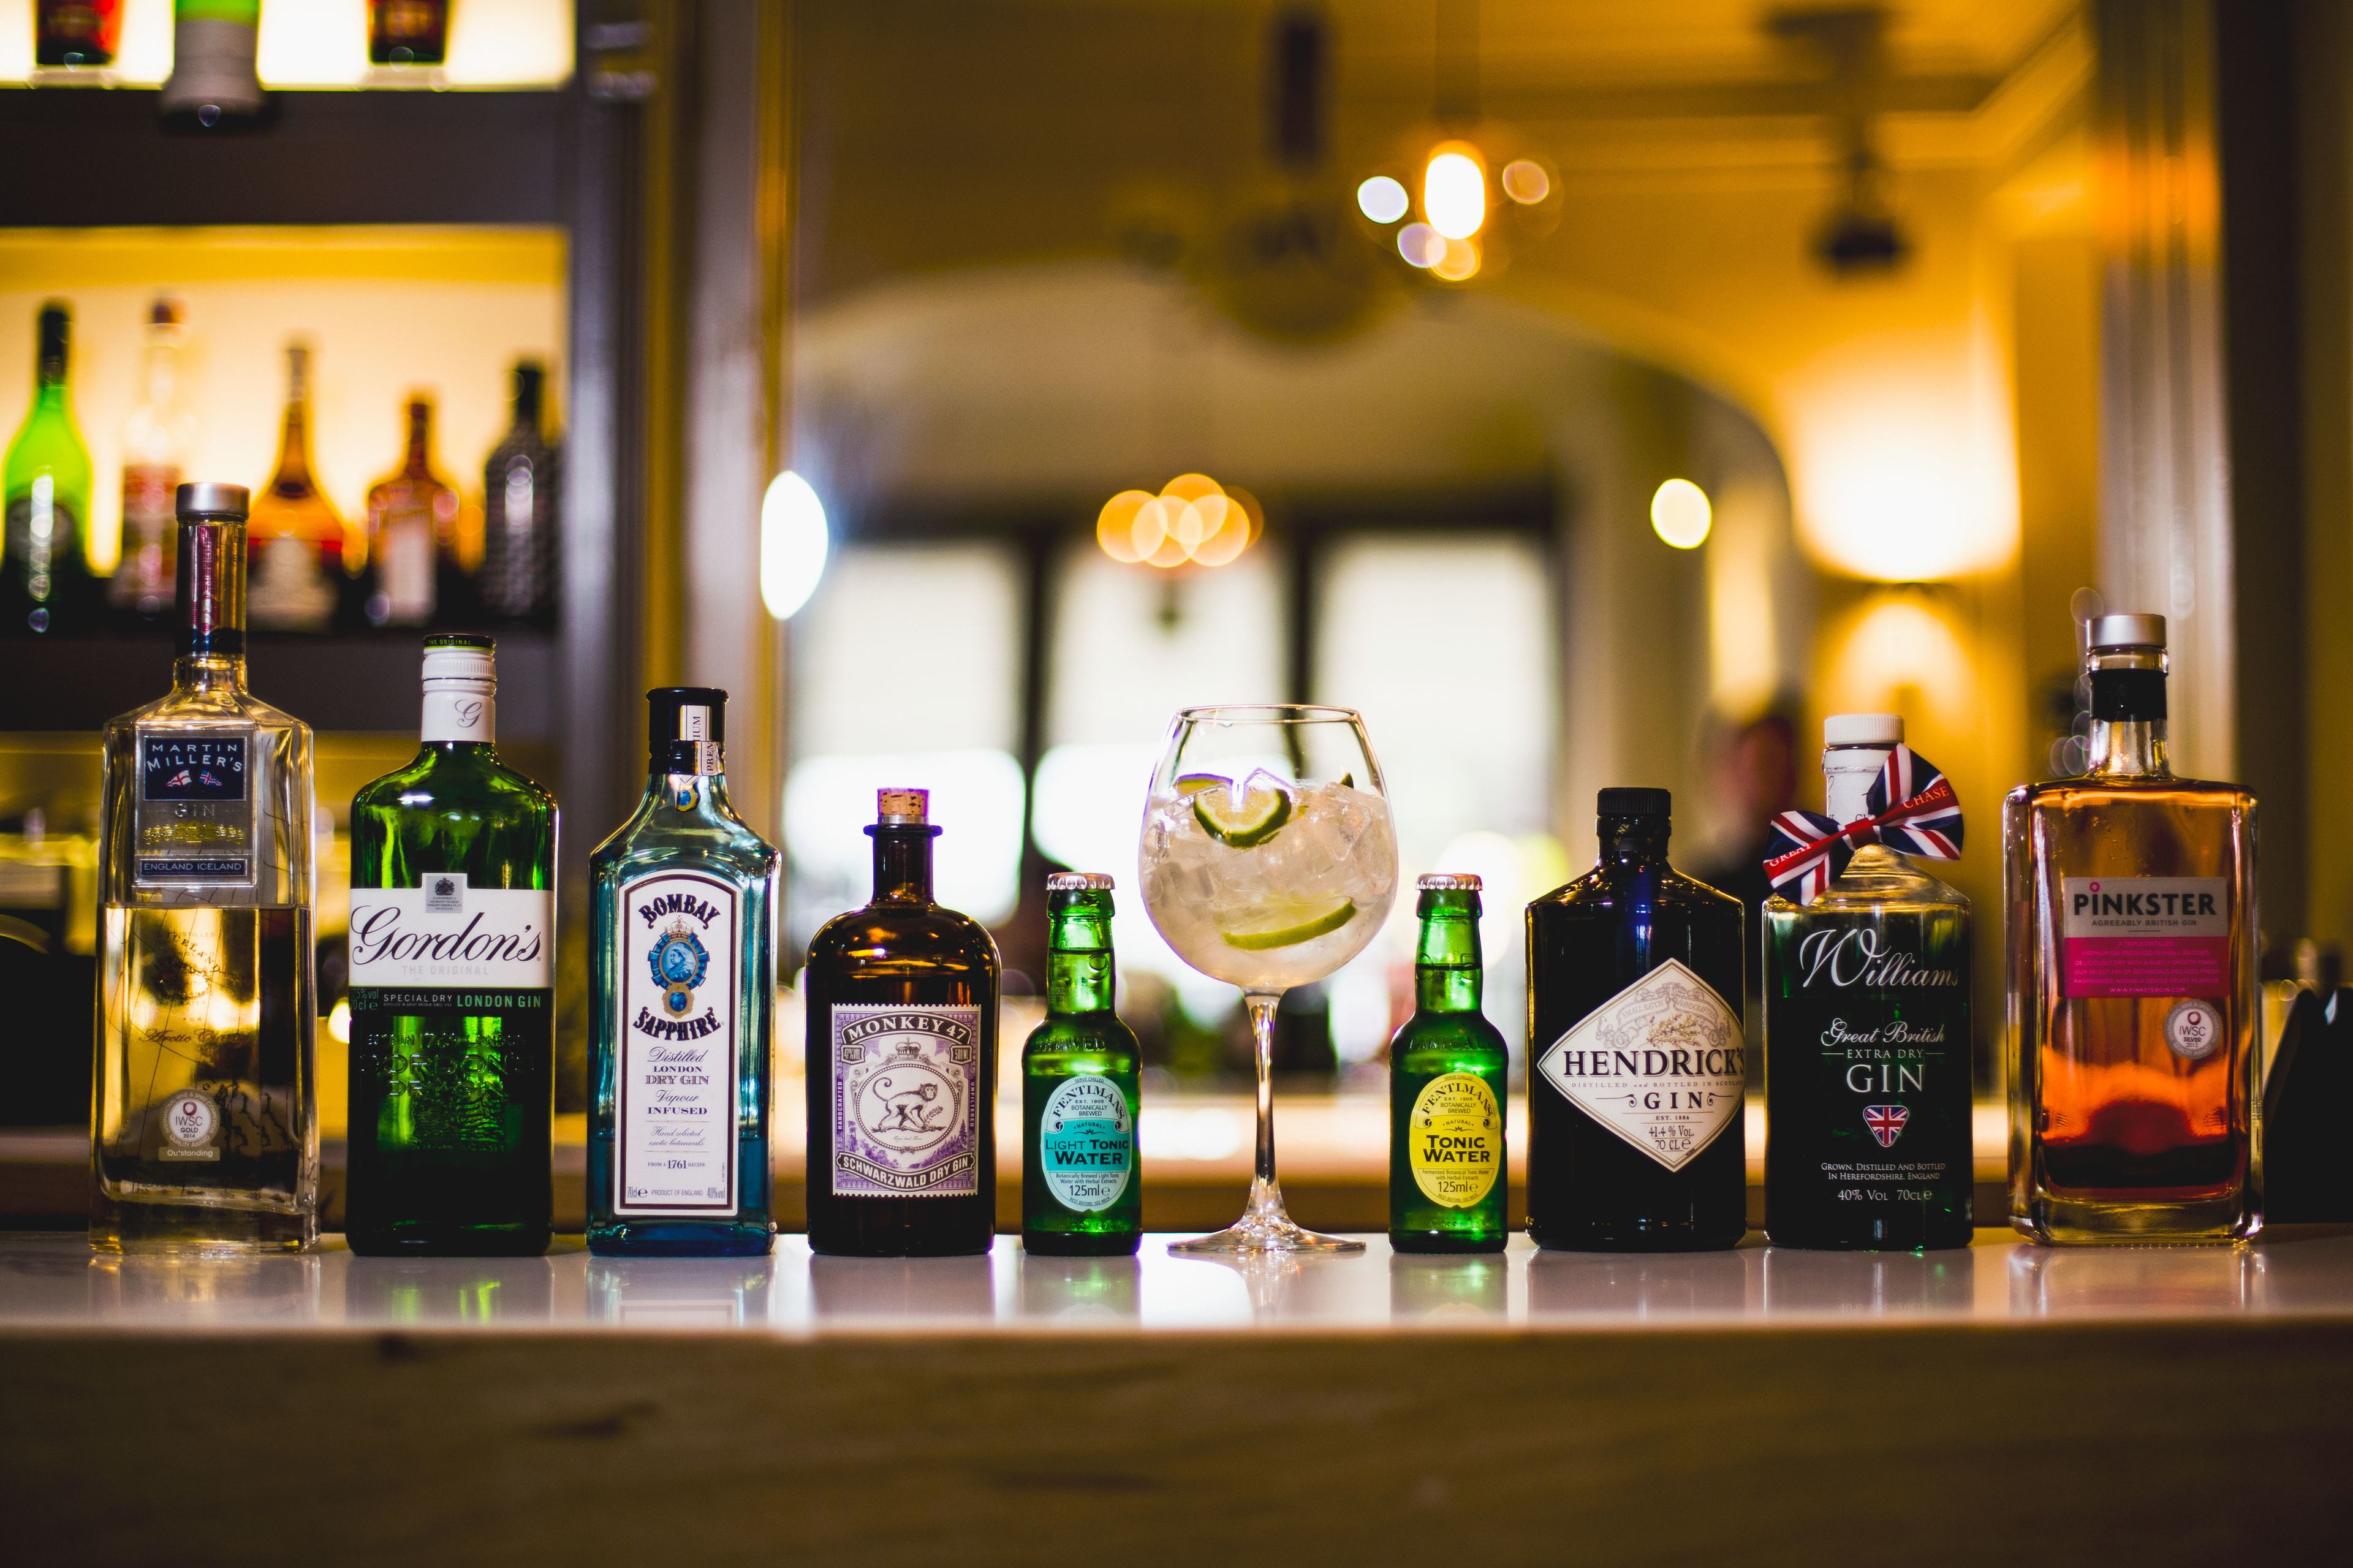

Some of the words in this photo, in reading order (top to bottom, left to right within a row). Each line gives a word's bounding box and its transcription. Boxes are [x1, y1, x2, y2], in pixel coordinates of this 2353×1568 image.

[455, 699, 482, 728] G
[147, 754, 243, 772] MILLER'S
[1903, 786, 1950, 809] CHASE
[175, 803, 214, 817] GIN
[2074, 882, 2217, 915] PINKSTER
[638, 893, 721, 930] BOMBAY
[350, 905, 542, 965] Gordon's
[1800, 928, 1959, 988] Williams
[402, 966, 423, 975] THE
[430, 966, 489, 975] ORIGINAL
[368, 988, 379, 999] vol
[457, 995, 513, 1007] LONDON
[518, 995, 541, 1007] GIN
[1621, 1005, 1643, 1018] SMALL
[1644, 1000, 1664, 1010] BATCH
[633, 1006, 721, 1042] SAPPHIRE
[847, 1016, 944, 1041] MONKEY
[946, 1025, 967, 1040] 47
[2180, 1026, 2206, 1036] IWSC
[1821, 1018, 1881, 1046] Great
[1882, 1021, 1945, 1042] British
[647, 1047, 708, 1062] Distilled
[1847, 1049, 1891, 1058] EXTRA
[1898, 1049, 1924, 1058] DRY
[645, 1075, 676, 1085] DRY
[680, 1075, 710, 1085] GIN
[1846, 1064, 1924, 1093] GIN
[656, 1089, 699, 1105] Vapour
[1053, 1085, 1126, 1119] FENTIMANS
[1422, 1082, 1494, 1116] FENTIMANS
[1644, 1092, 1703, 1110] GIN
[175, 1116, 203, 1126] IWSC
[651, 1126, 676, 1136] Hand
[676, 1127, 703, 1136] selected
[669, 1137, 706, 1146] botanicals
[1046, 1139, 1086, 1149] LIGHT
[1089, 1139, 1129, 1149] TONIC
[1426, 1135, 1485, 1148] TONIC
[167, 1149, 213, 1158] Outstanding
[1054, 1151, 1123, 1165] WATER
[1423, 1148, 1490, 1162] WATER
[667, 1160, 687, 1169] 1761
[843, 1157, 926, 1188] SCHWARZWALD
[930, 1167, 950, 1181] DRY
[953, 1156, 968, 1172] GIN
[1069, 1184, 1099, 1196] 125ml
[1438, 1181, 1468, 1192] 125ml
[1838, 1190, 1863, 1201] 40%
[1866, 1190, 1889, 1201] VOL
